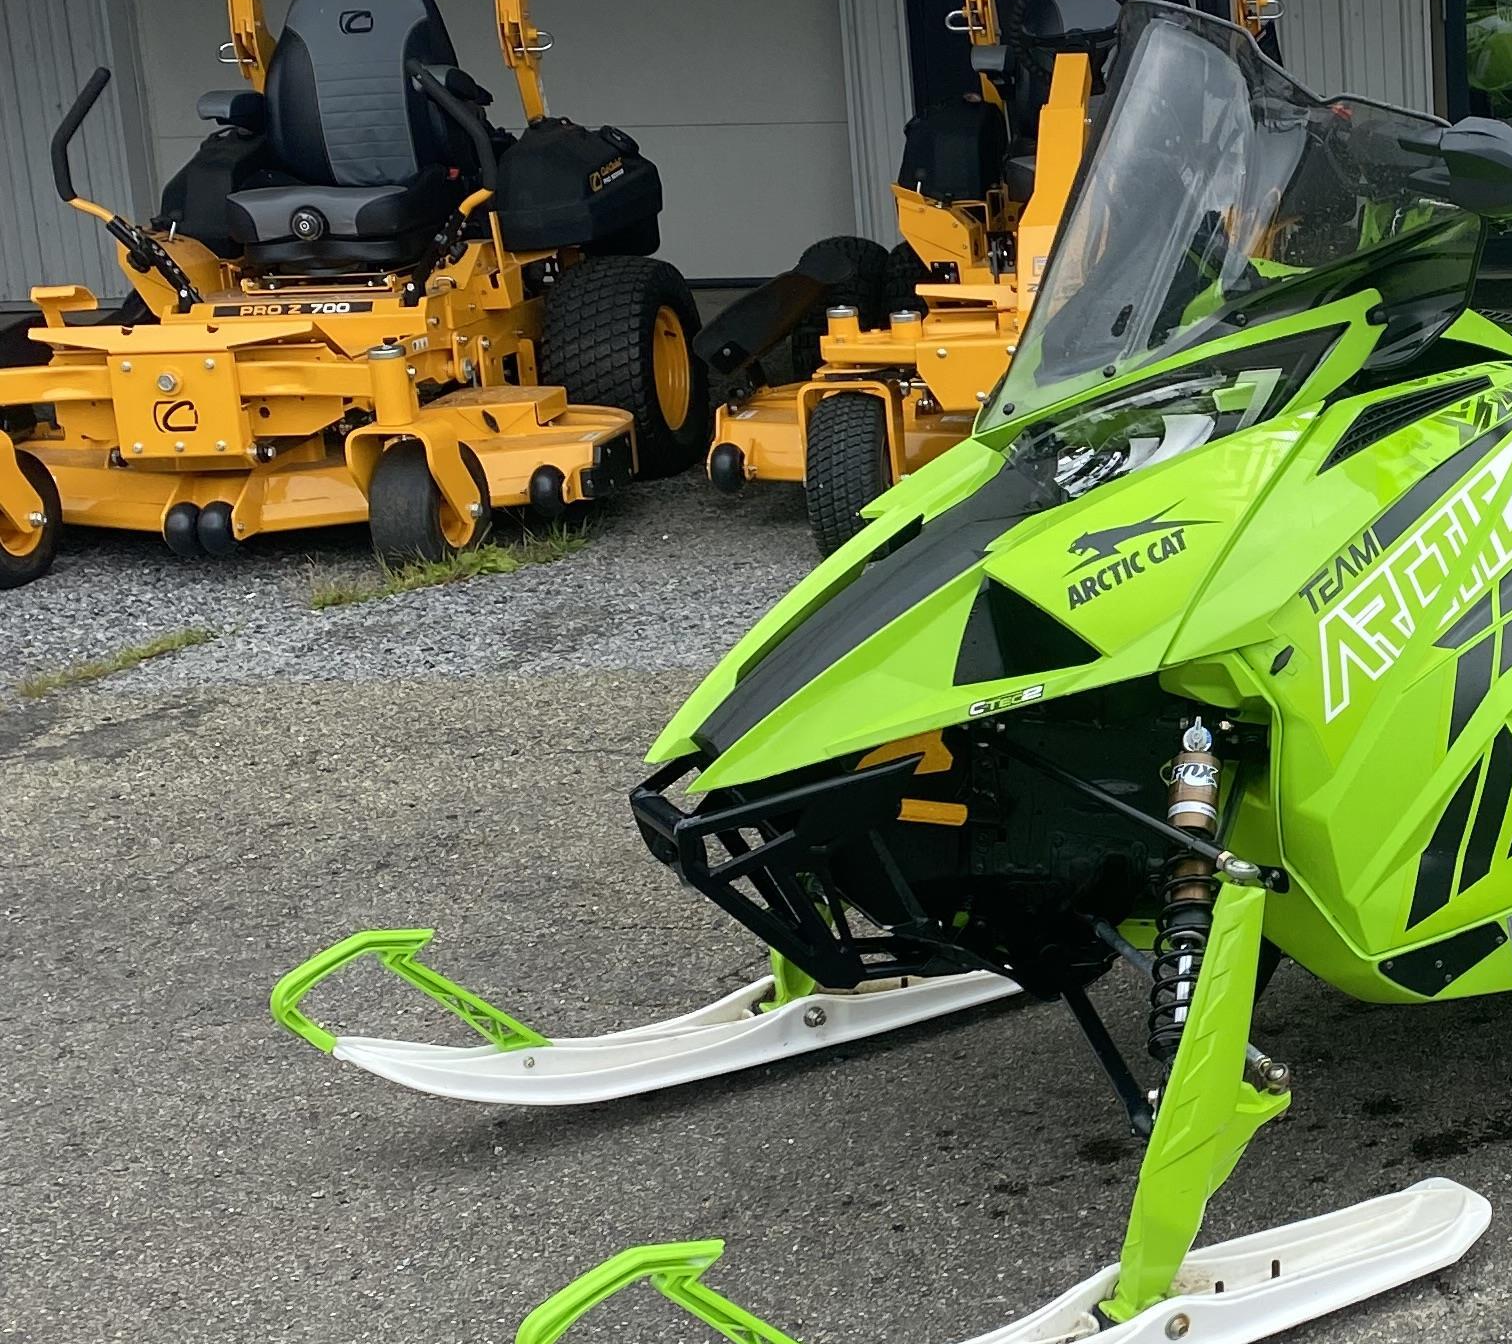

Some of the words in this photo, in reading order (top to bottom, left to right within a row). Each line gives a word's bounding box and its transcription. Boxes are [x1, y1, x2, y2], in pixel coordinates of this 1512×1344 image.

[240, 306, 282, 316] PRO
[287, 305, 302, 315] Z
[310, 303, 351, 314] 700
[1067, 550, 1145, 611] ARCTIC
[1147, 527, 1187, 565] CAT
[1299, 527, 1384, 614] TEAM
[1172, 762, 1218, 783] FOX
